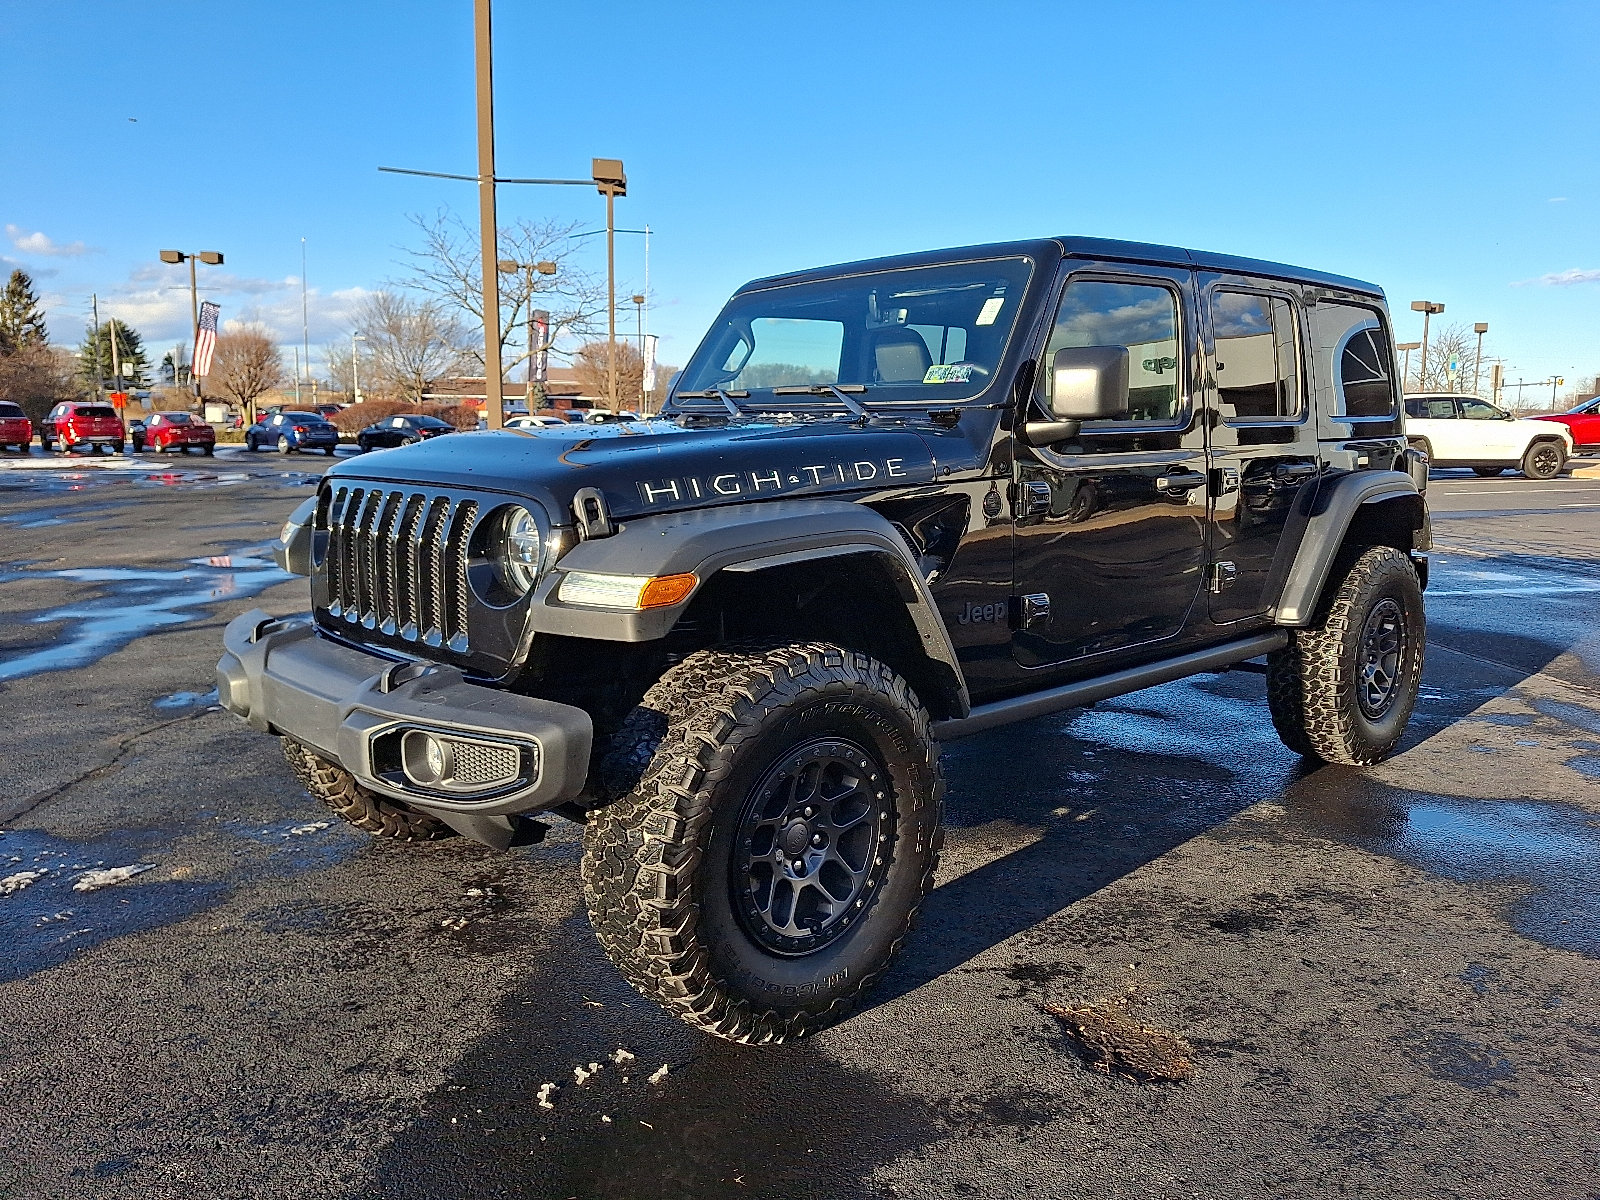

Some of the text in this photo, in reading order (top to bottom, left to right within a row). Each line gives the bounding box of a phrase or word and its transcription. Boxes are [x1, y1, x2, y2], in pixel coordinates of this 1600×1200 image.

[644, 458, 907, 503] HIGH TIDE
[957, 601, 1005, 625] Jeep
